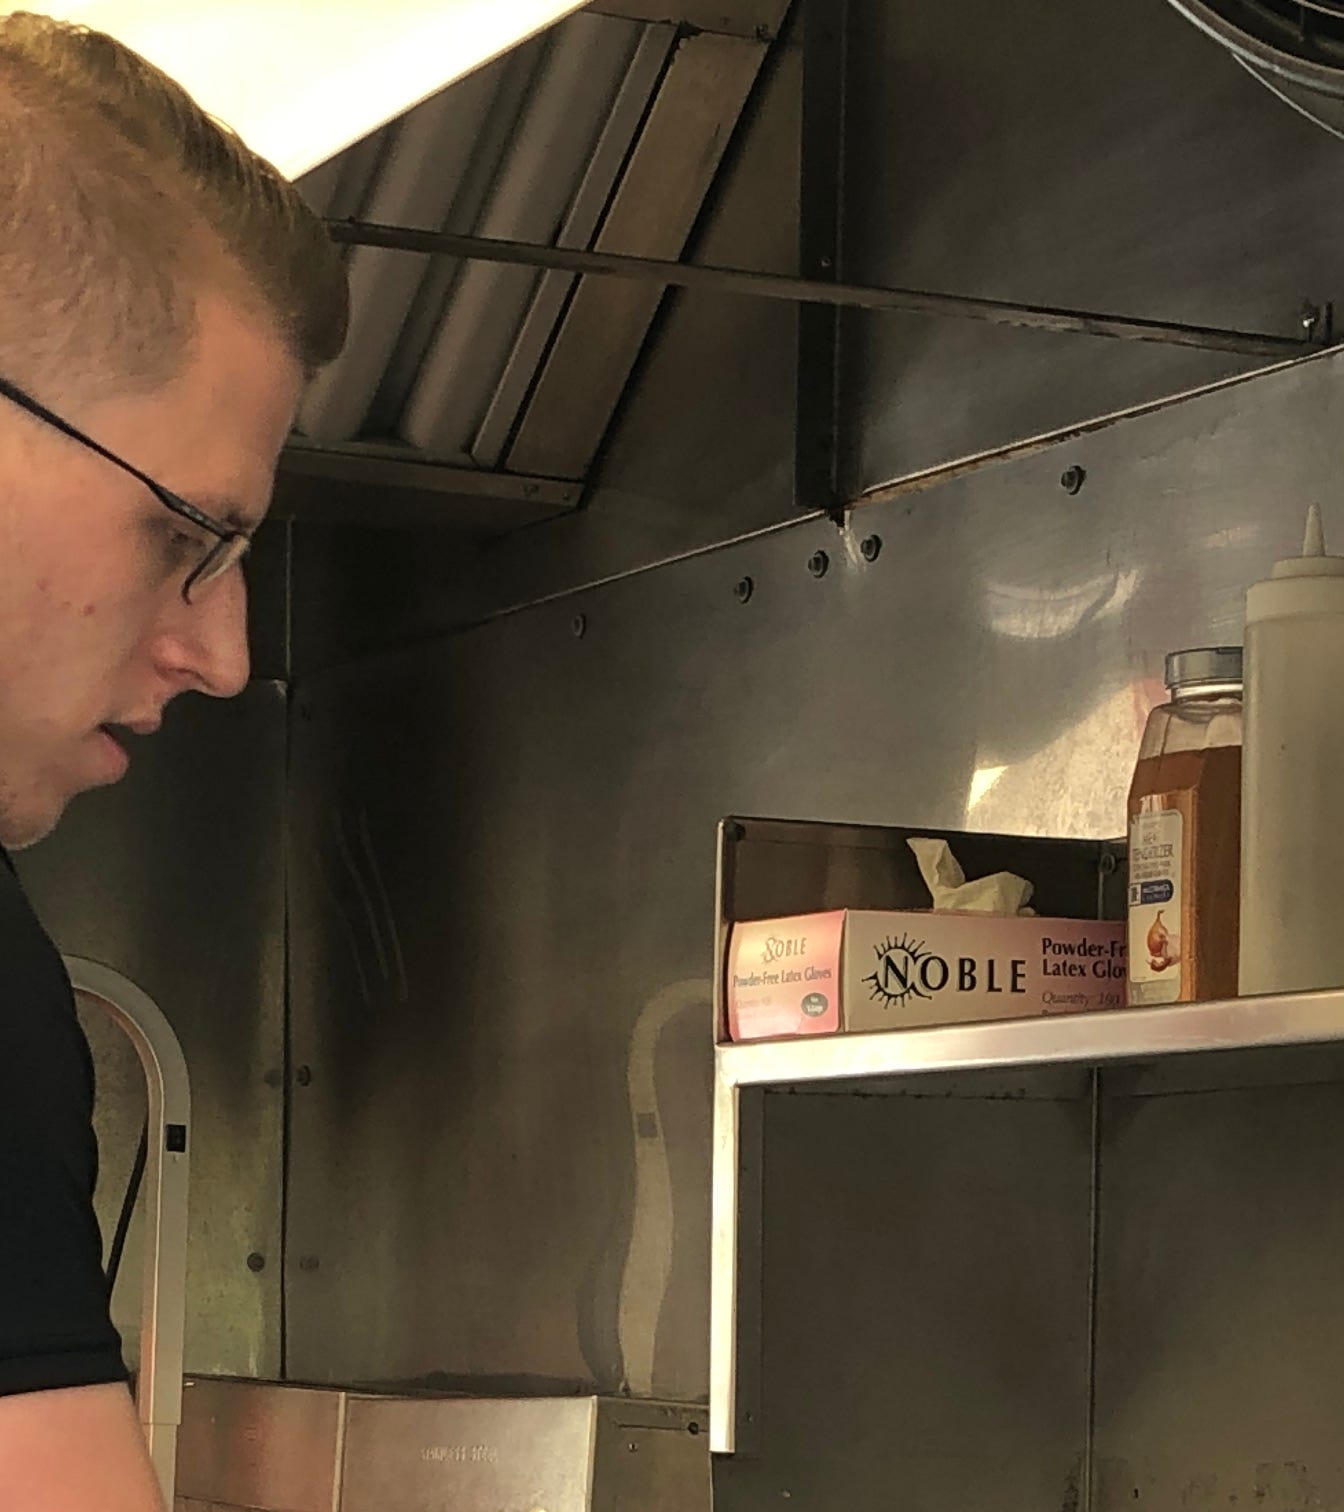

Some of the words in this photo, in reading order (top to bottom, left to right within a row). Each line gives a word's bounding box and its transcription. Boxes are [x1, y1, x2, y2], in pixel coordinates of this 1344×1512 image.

[1041, 937, 1126, 957] Powder-Fr
[733, 970, 779, 987] Powder-Free
[781, 969, 802, 983] Latex
[804, 965, 832, 981] Gloves
[883, 954, 1026, 993] NOBLE
[1042, 958, 1086, 977] Latex
[1092, 959, 1127, 979] Glov
